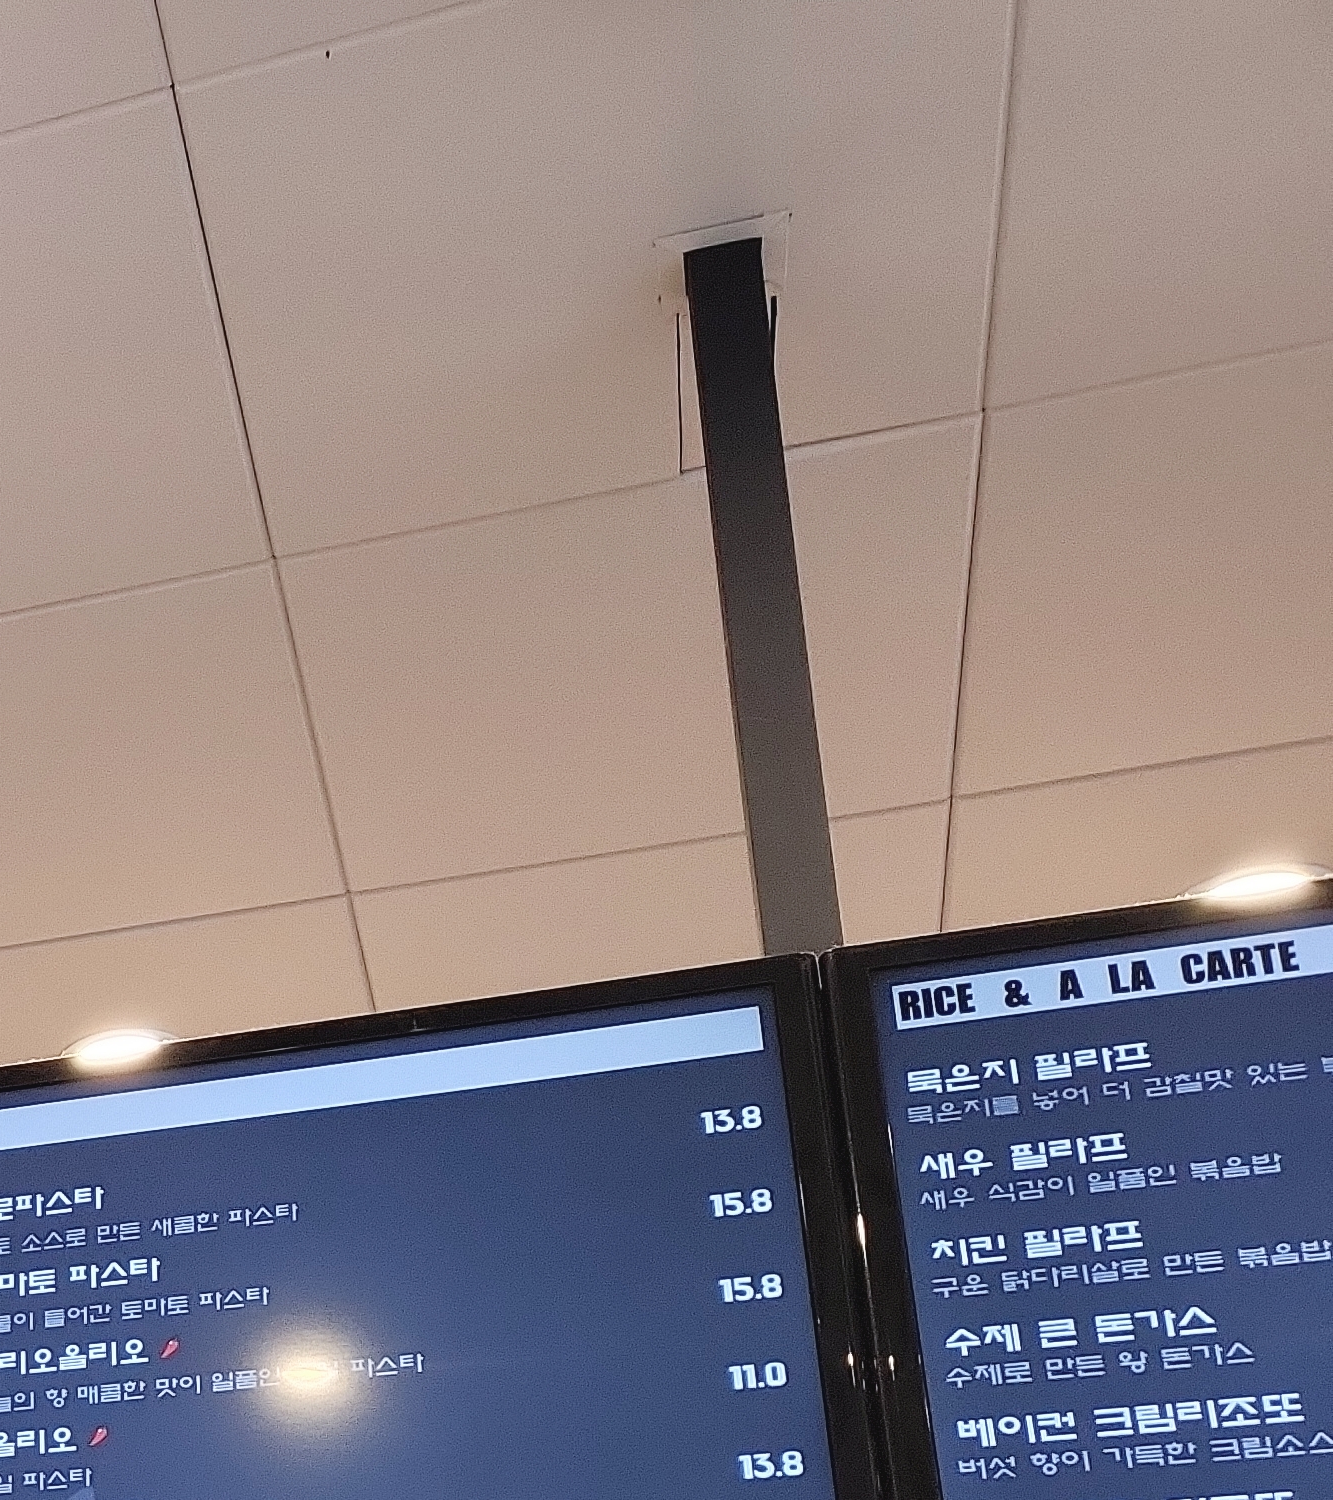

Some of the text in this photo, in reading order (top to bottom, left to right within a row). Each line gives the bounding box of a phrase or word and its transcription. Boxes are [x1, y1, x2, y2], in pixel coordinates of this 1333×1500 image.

[899, 941, 1299, 1021] RICE & A LA CARTE
[908, 1042, 1152, 1093] 묵은지 필라프
[701, 1106, 761, 1133] 13.8
[921, 1133, 1127, 1179] 새우 필라프
[710, 1189, 772, 1217] 15.8
[22, 1229, 86, 1252] 소스로
[98, 1222, 140, 1243] 만든
[152, 1213, 218, 1236] 새콤한
[229, 1204, 297, 1226] 파스타
[932, 1221, 1143, 1265] 치킨 필라프
[70, 1258, 160, 1288] 파스타
[719, 1274, 782, 1302] 15.8
[946, 1307, 1217, 1356] 수제 큰 돈가스
[729, 1363, 786, 1389] 11.0
[947, 1362, 1032, 1388] 수제로
[1046, 1355, 1105, 1379] 만든
[1161, 1343, 1254, 1369] 돈가스
[957, 1393, 1304, 1447] 베이컨 크림리조또
[739, 1451, 803, 1479] 13.8
